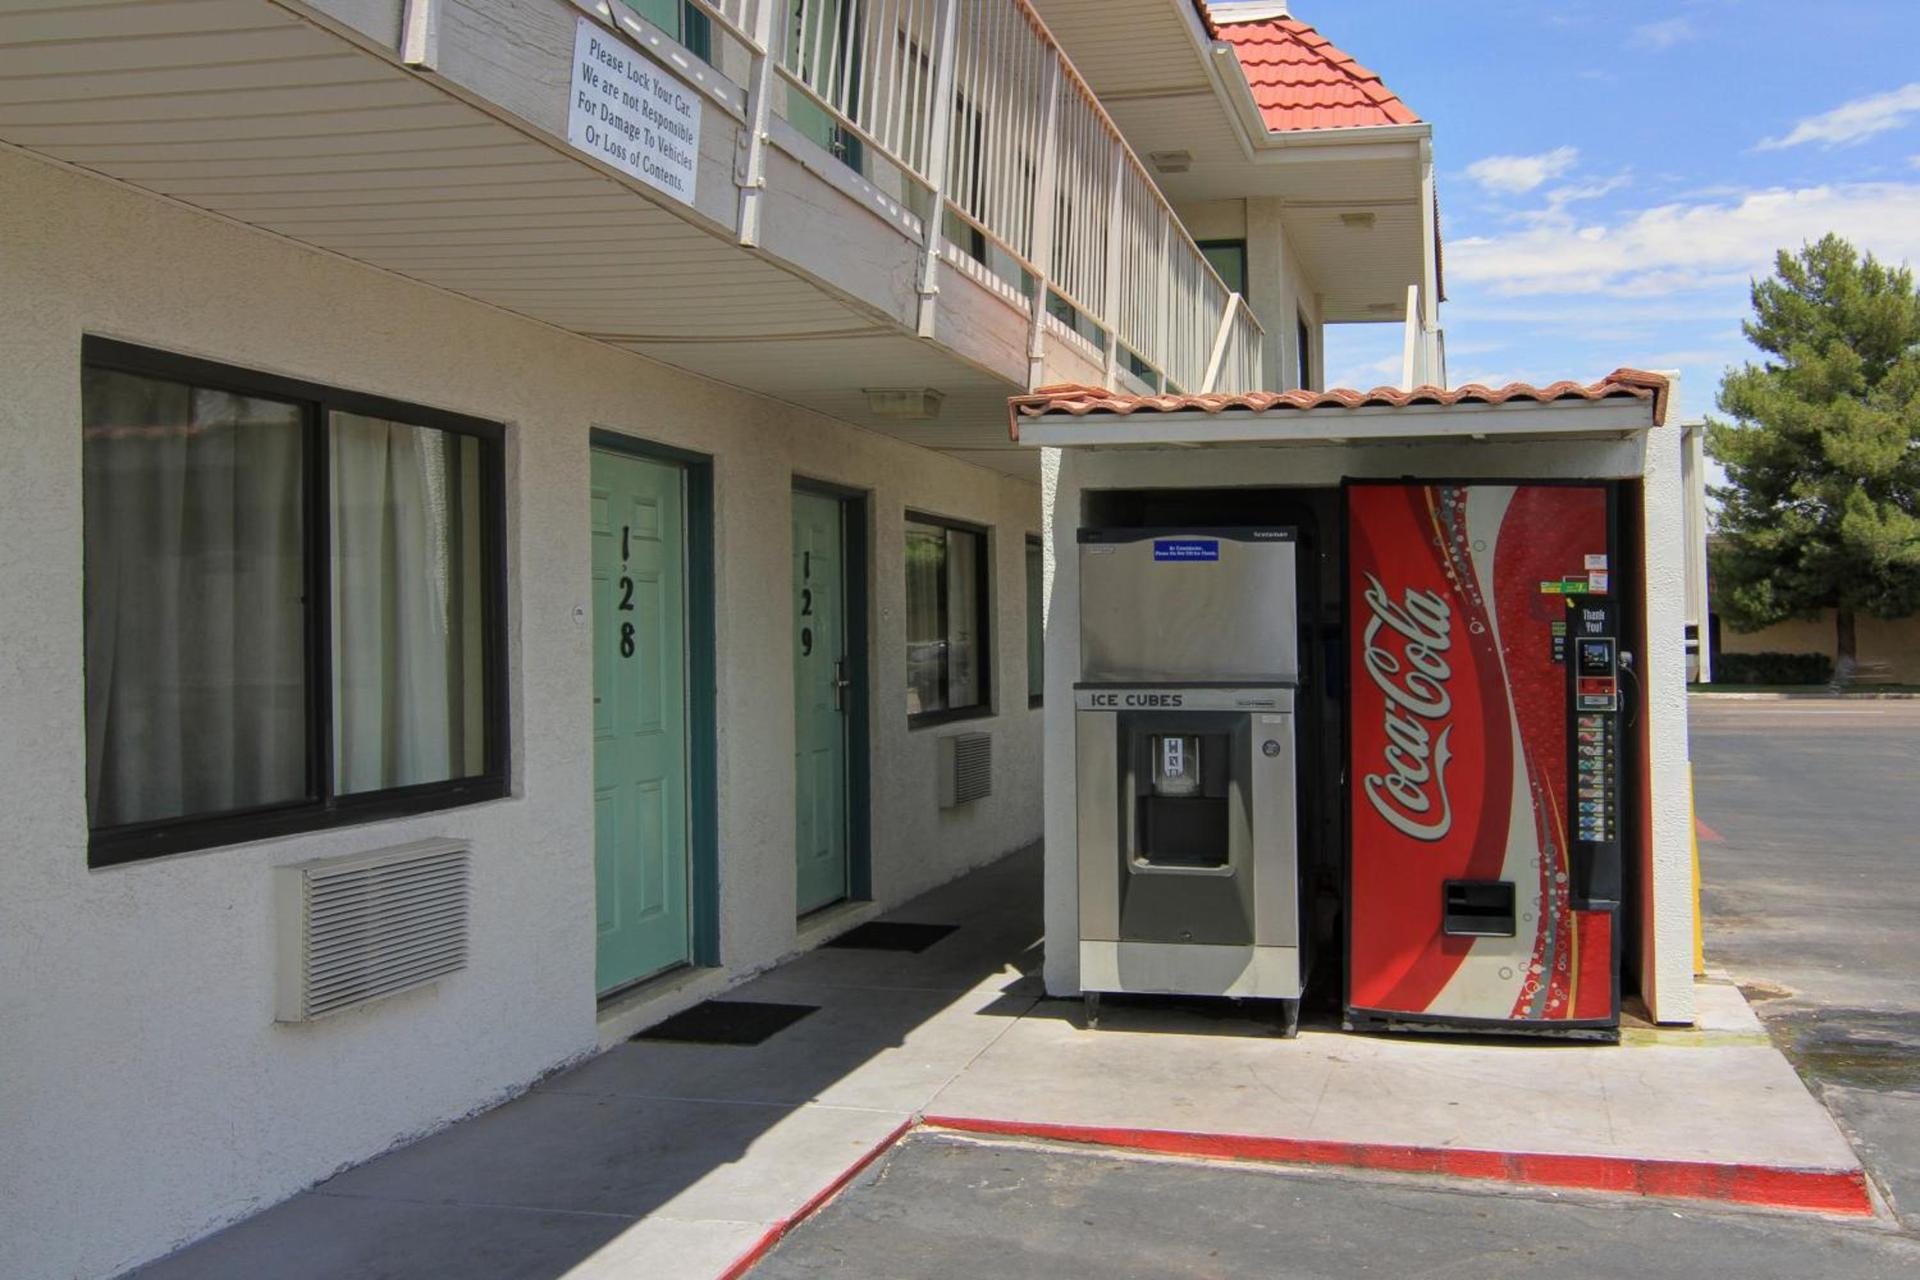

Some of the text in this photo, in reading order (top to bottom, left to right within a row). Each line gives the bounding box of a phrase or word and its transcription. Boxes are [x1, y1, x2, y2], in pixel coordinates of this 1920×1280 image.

[582, 62, 693, 146] We are not Responsible
[589, 38, 691, 119] Please Lock Your Car.
[577, 90, 693, 171] For Damage To Vehicles
[585, 125, 685, 193] Or Loss of Contents.
[619, 525, 635, 659] 128
[801, 551, 812, 657] 129
[1583, 608, 1606, 621] Thank
[1586, 621, 1603, 633] You!
[1091, 694, 1183, 707] ICE CUBES
[1364, 570, 1453, 842] Coca-Cola
